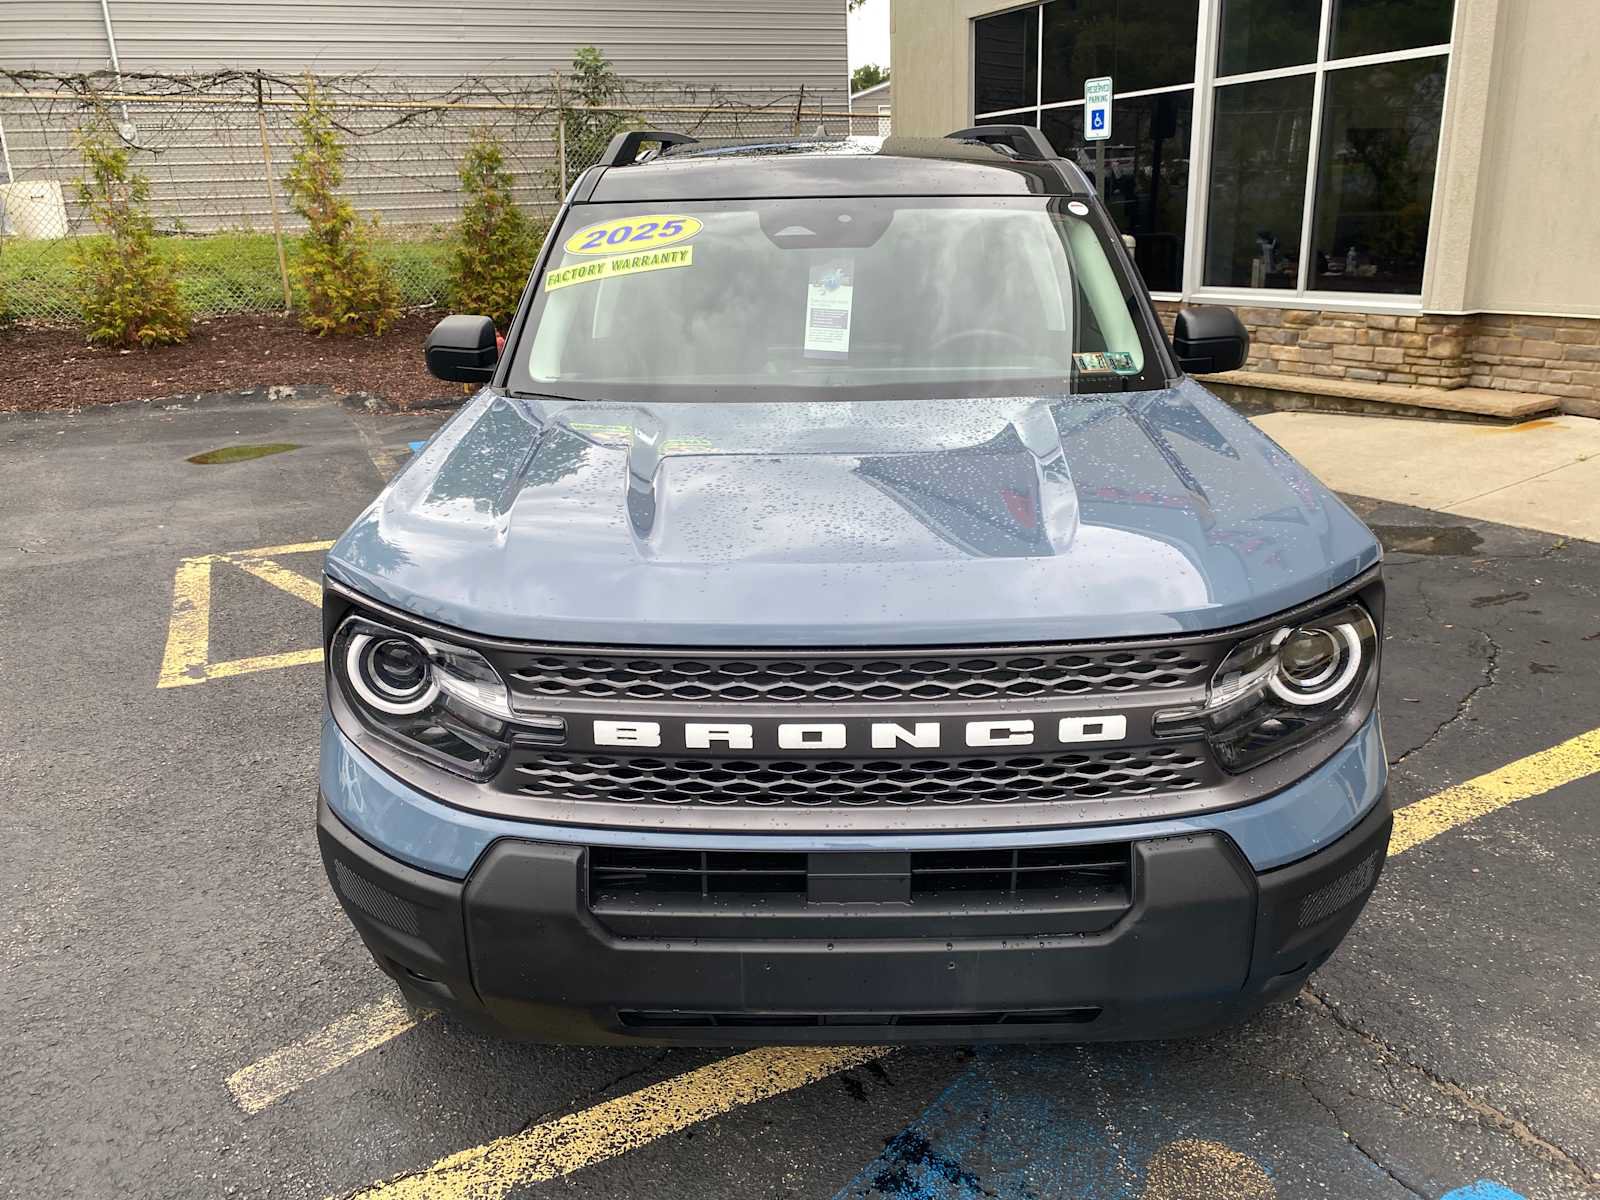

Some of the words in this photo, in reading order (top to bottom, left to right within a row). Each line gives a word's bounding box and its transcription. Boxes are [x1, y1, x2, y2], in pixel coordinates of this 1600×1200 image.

[1088, 94, 1108, 103] PARKING
[580, 219, 687, 250] 2025
[547, 263, 606, 286] FACTORY
[611, 250, 689, 272] WARRANTY
[593, 715, 1127, 750] BRONCO
